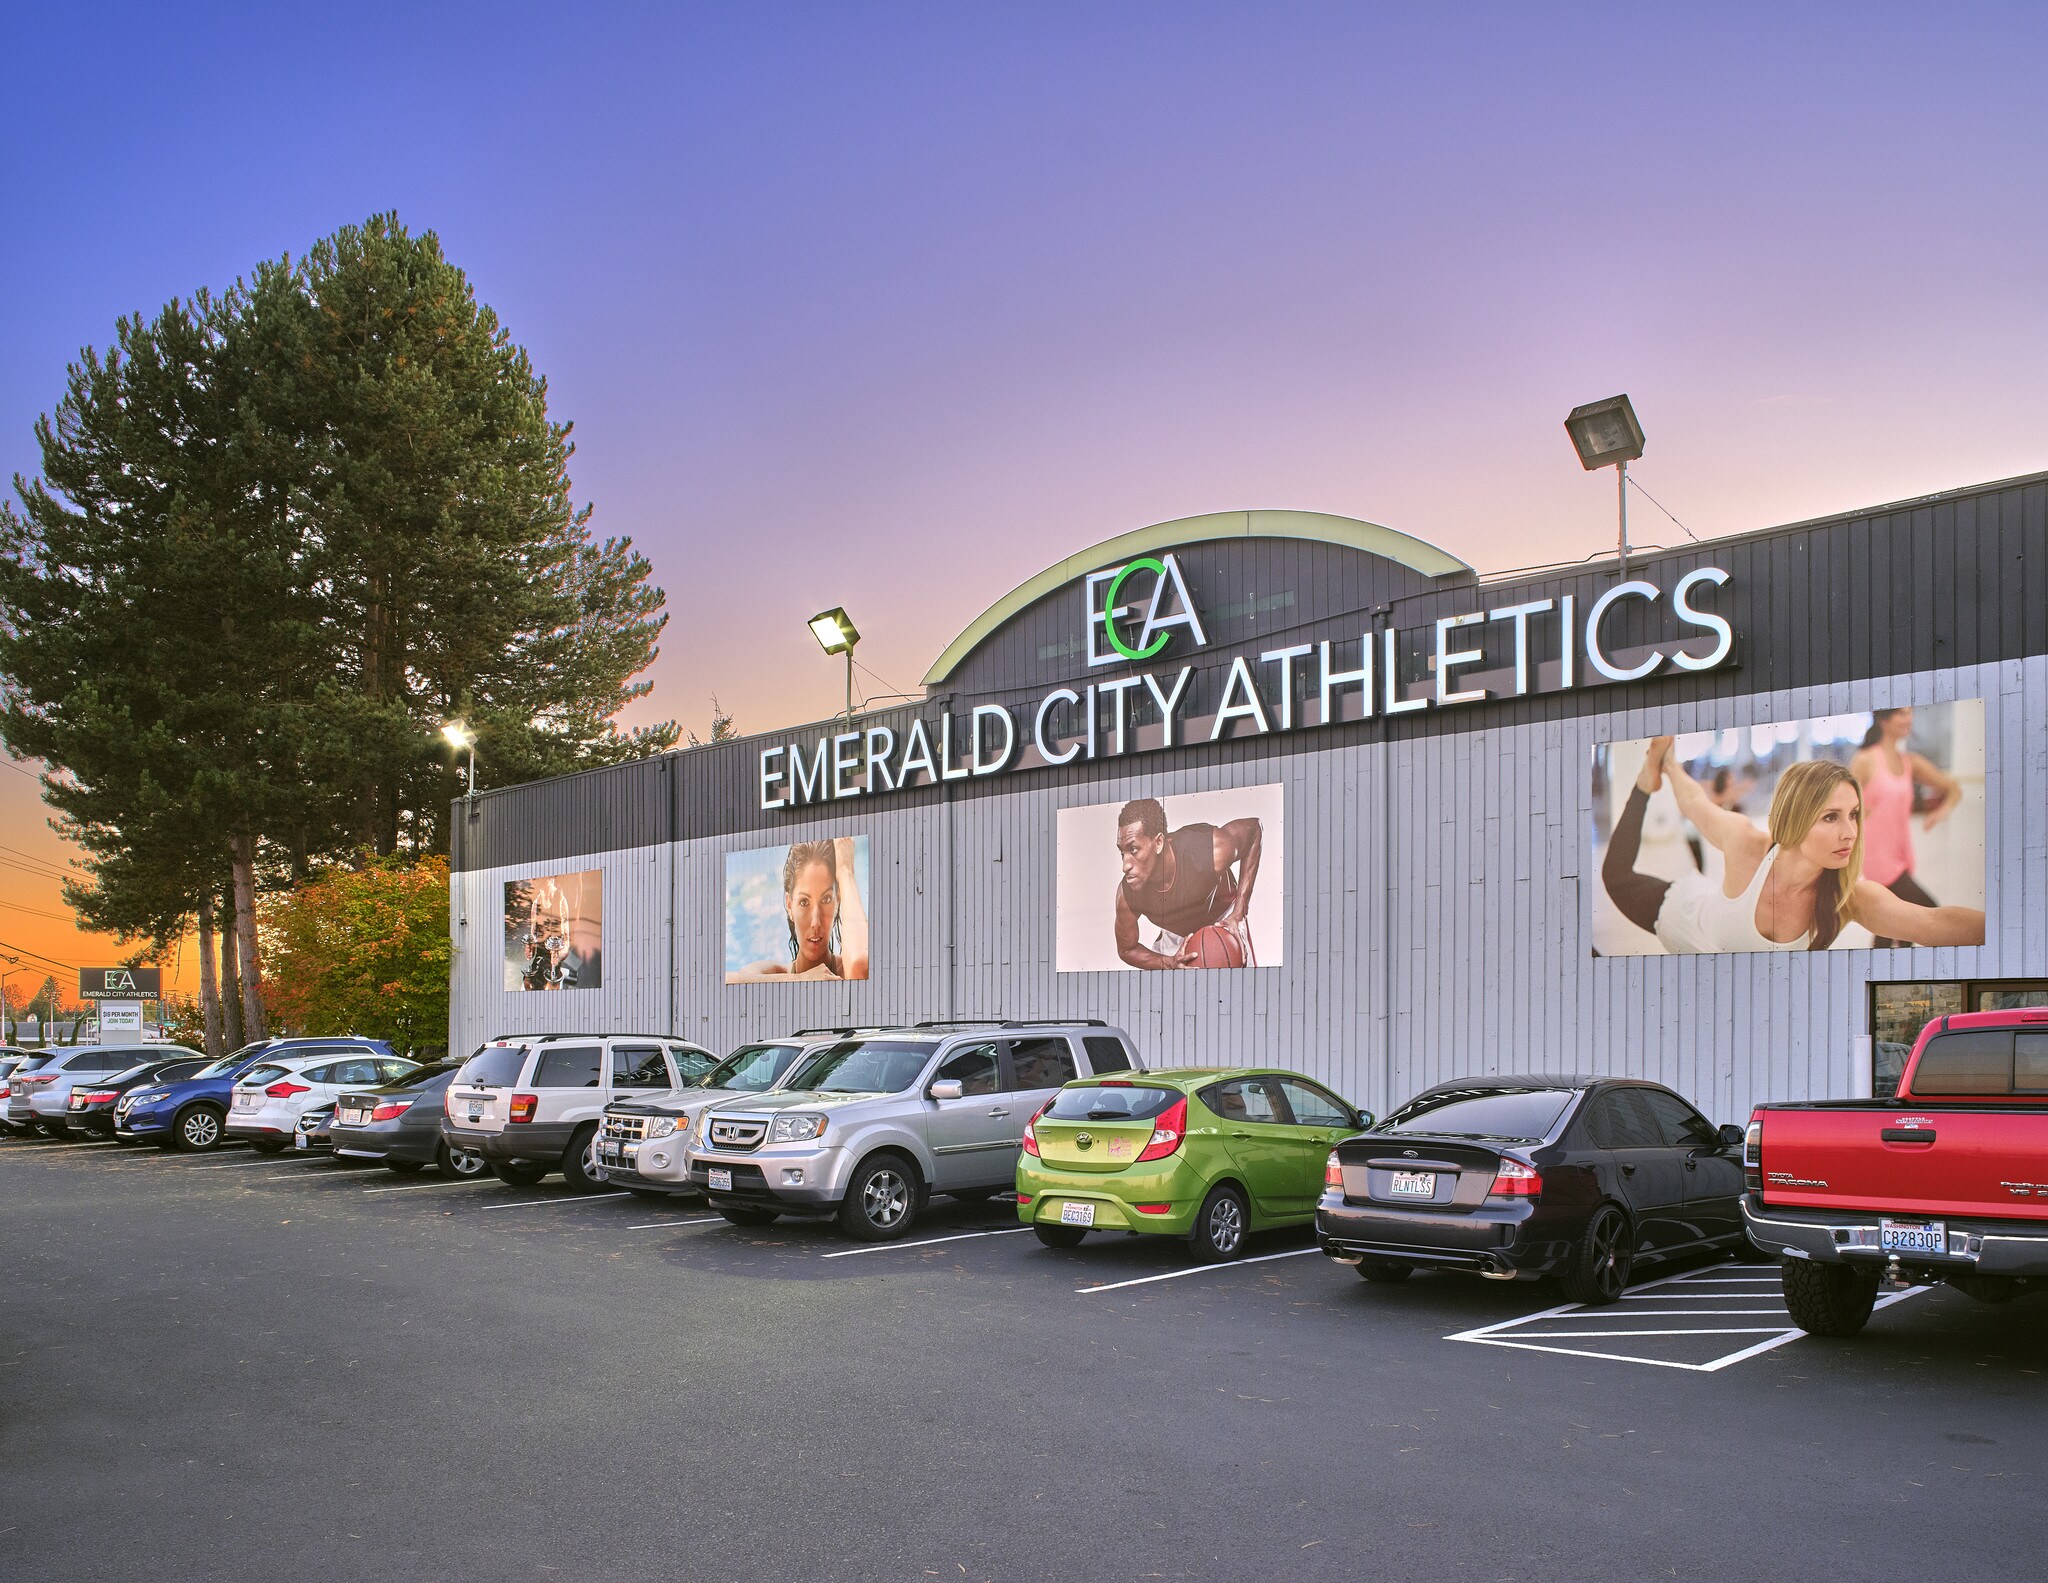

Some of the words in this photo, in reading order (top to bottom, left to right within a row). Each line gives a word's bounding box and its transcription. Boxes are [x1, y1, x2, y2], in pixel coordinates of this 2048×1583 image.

[1086, 553, 1209, 668] ECA
[760, 704, 1018, 810] EMERALD
[1034, 665, 1196, 765] CITY
[1209, 567, 1736, 740] ATHLETICS
[104, 969, 137, 991] ECA
[1393, 1179, 1432, 1193] RLNTLSS
[1768, 1178, 1829, 1188] TACOMA
[1883, 1230, 1942, 1248] C82830P
